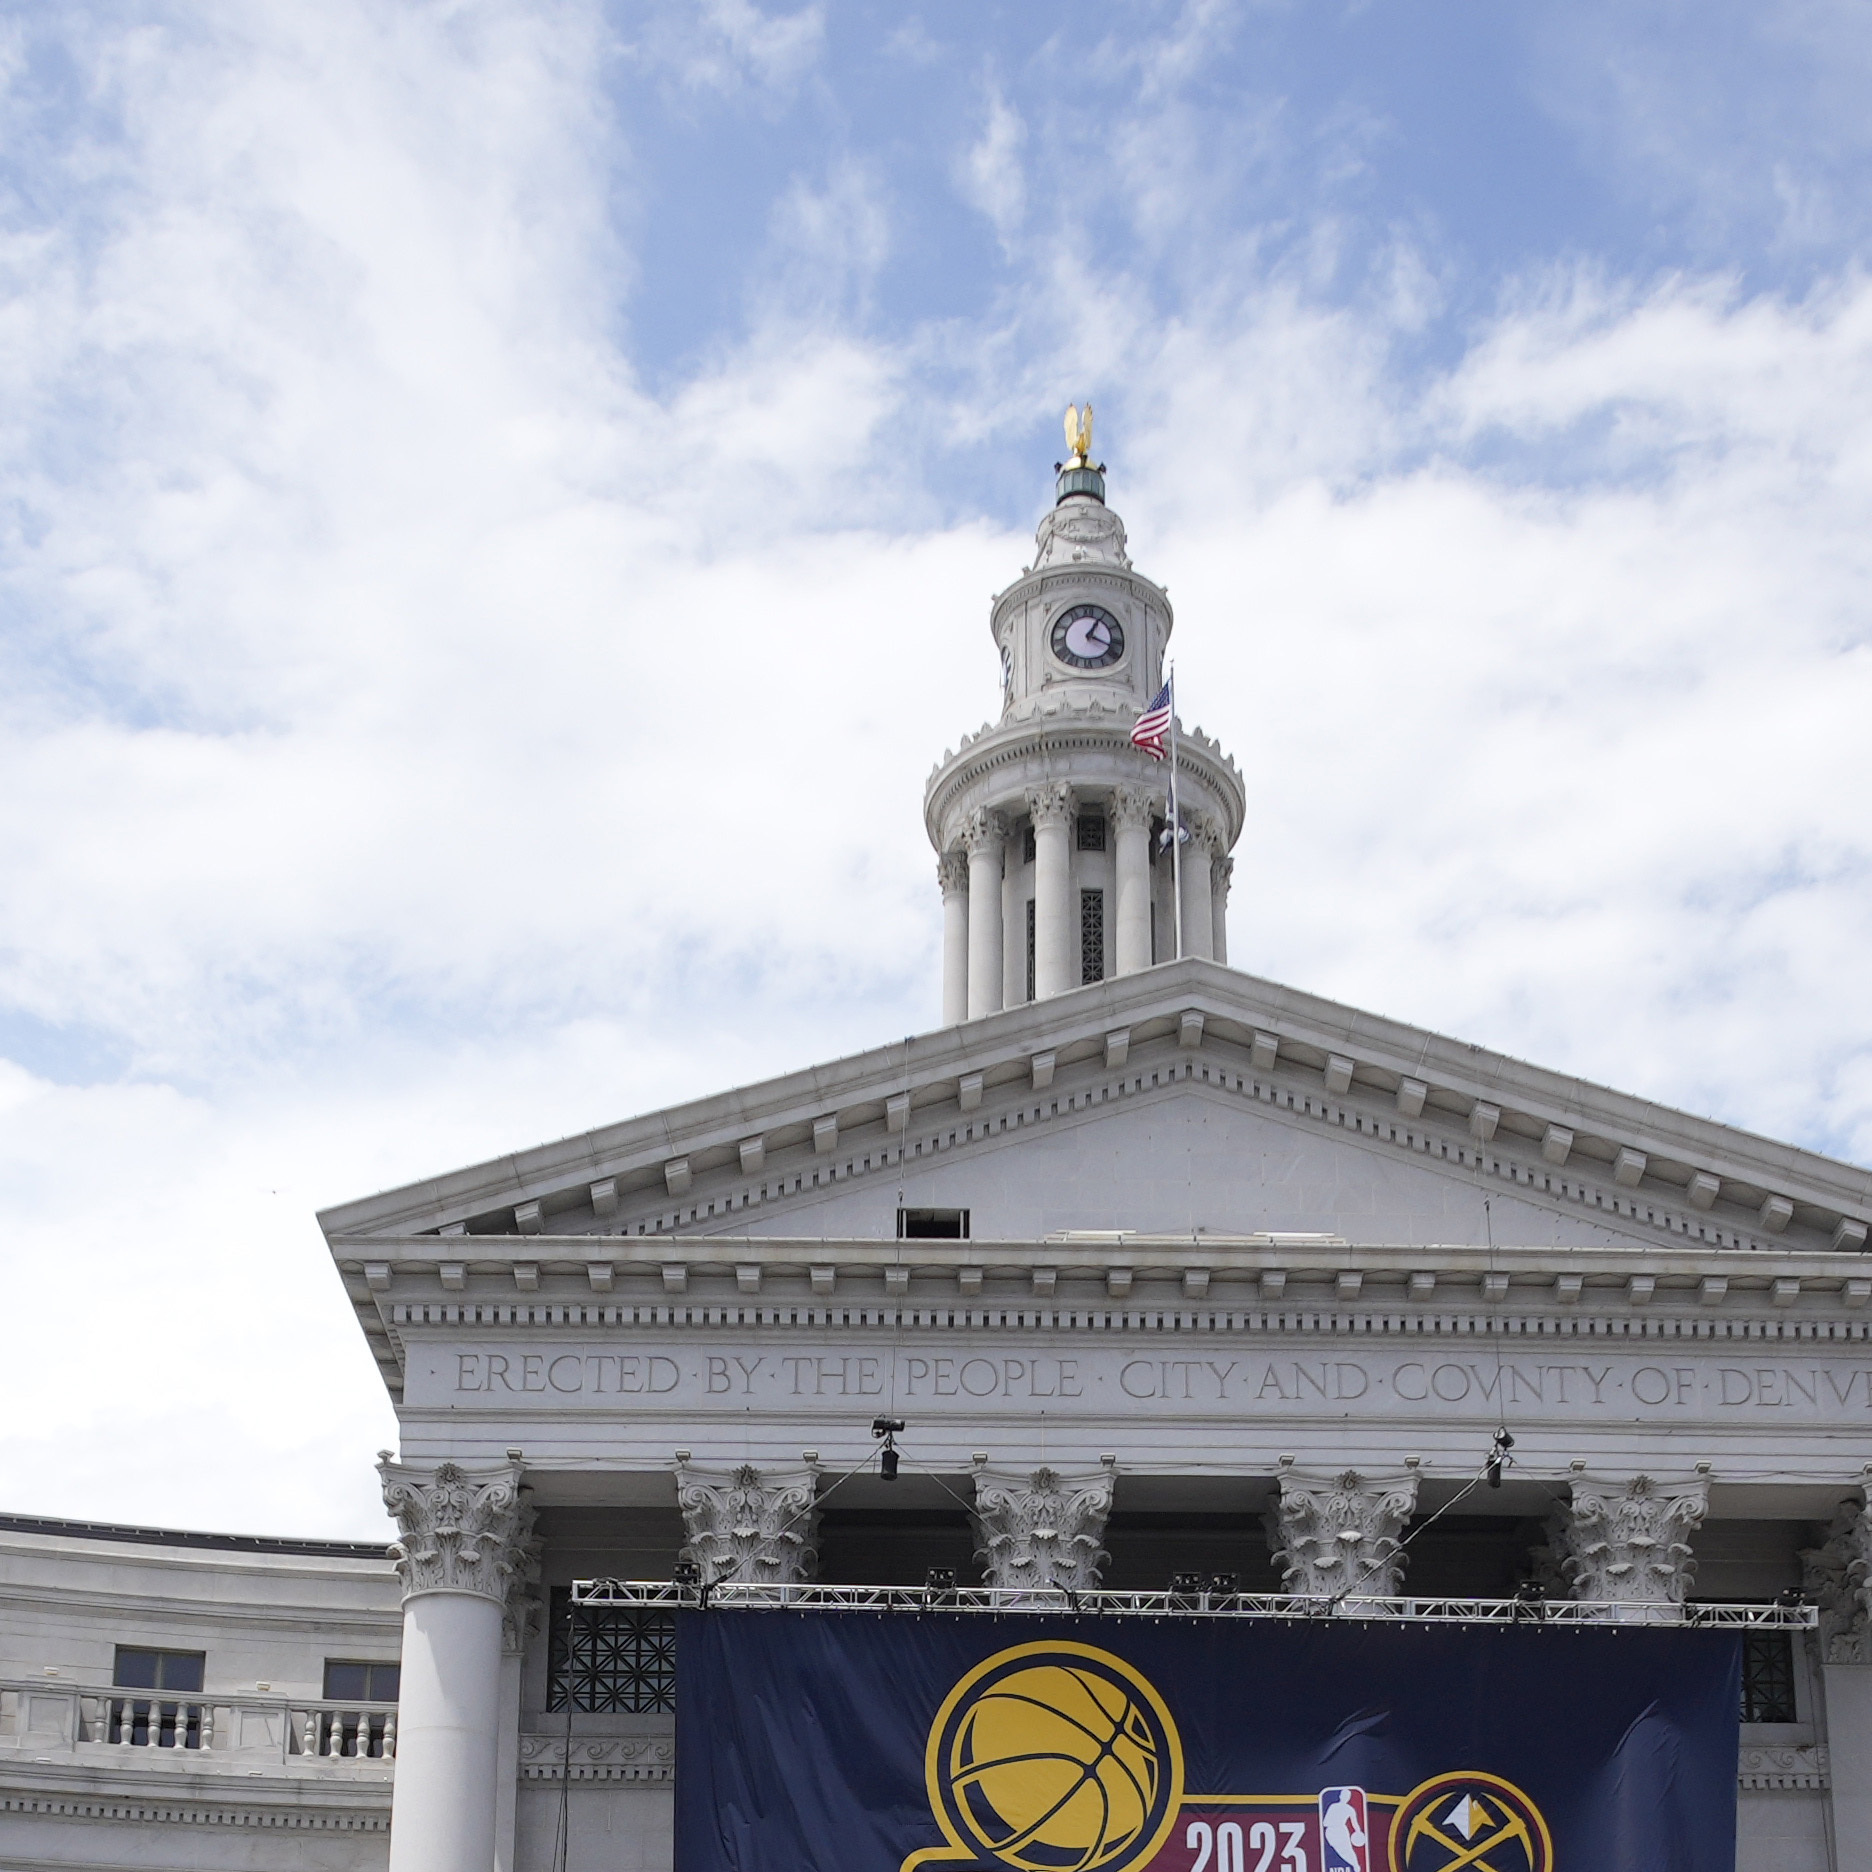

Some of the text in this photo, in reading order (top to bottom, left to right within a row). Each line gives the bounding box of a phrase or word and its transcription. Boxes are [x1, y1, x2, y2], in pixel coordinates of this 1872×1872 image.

[454, 1353, 680, 1394] ERECTED
[705, 1356, 767, 1395] BY
[782, 1357, 884, 1395] THE
[904, 1358, 1083, 1397] PEOPLE
[1119, 1360, 1237, 1400] CITY
[1257, 1362, 1369, 1400] AND
[1391, 1362, 1615, 1403] COVNTY
[1631, 1366, 1709, 1406] OF
